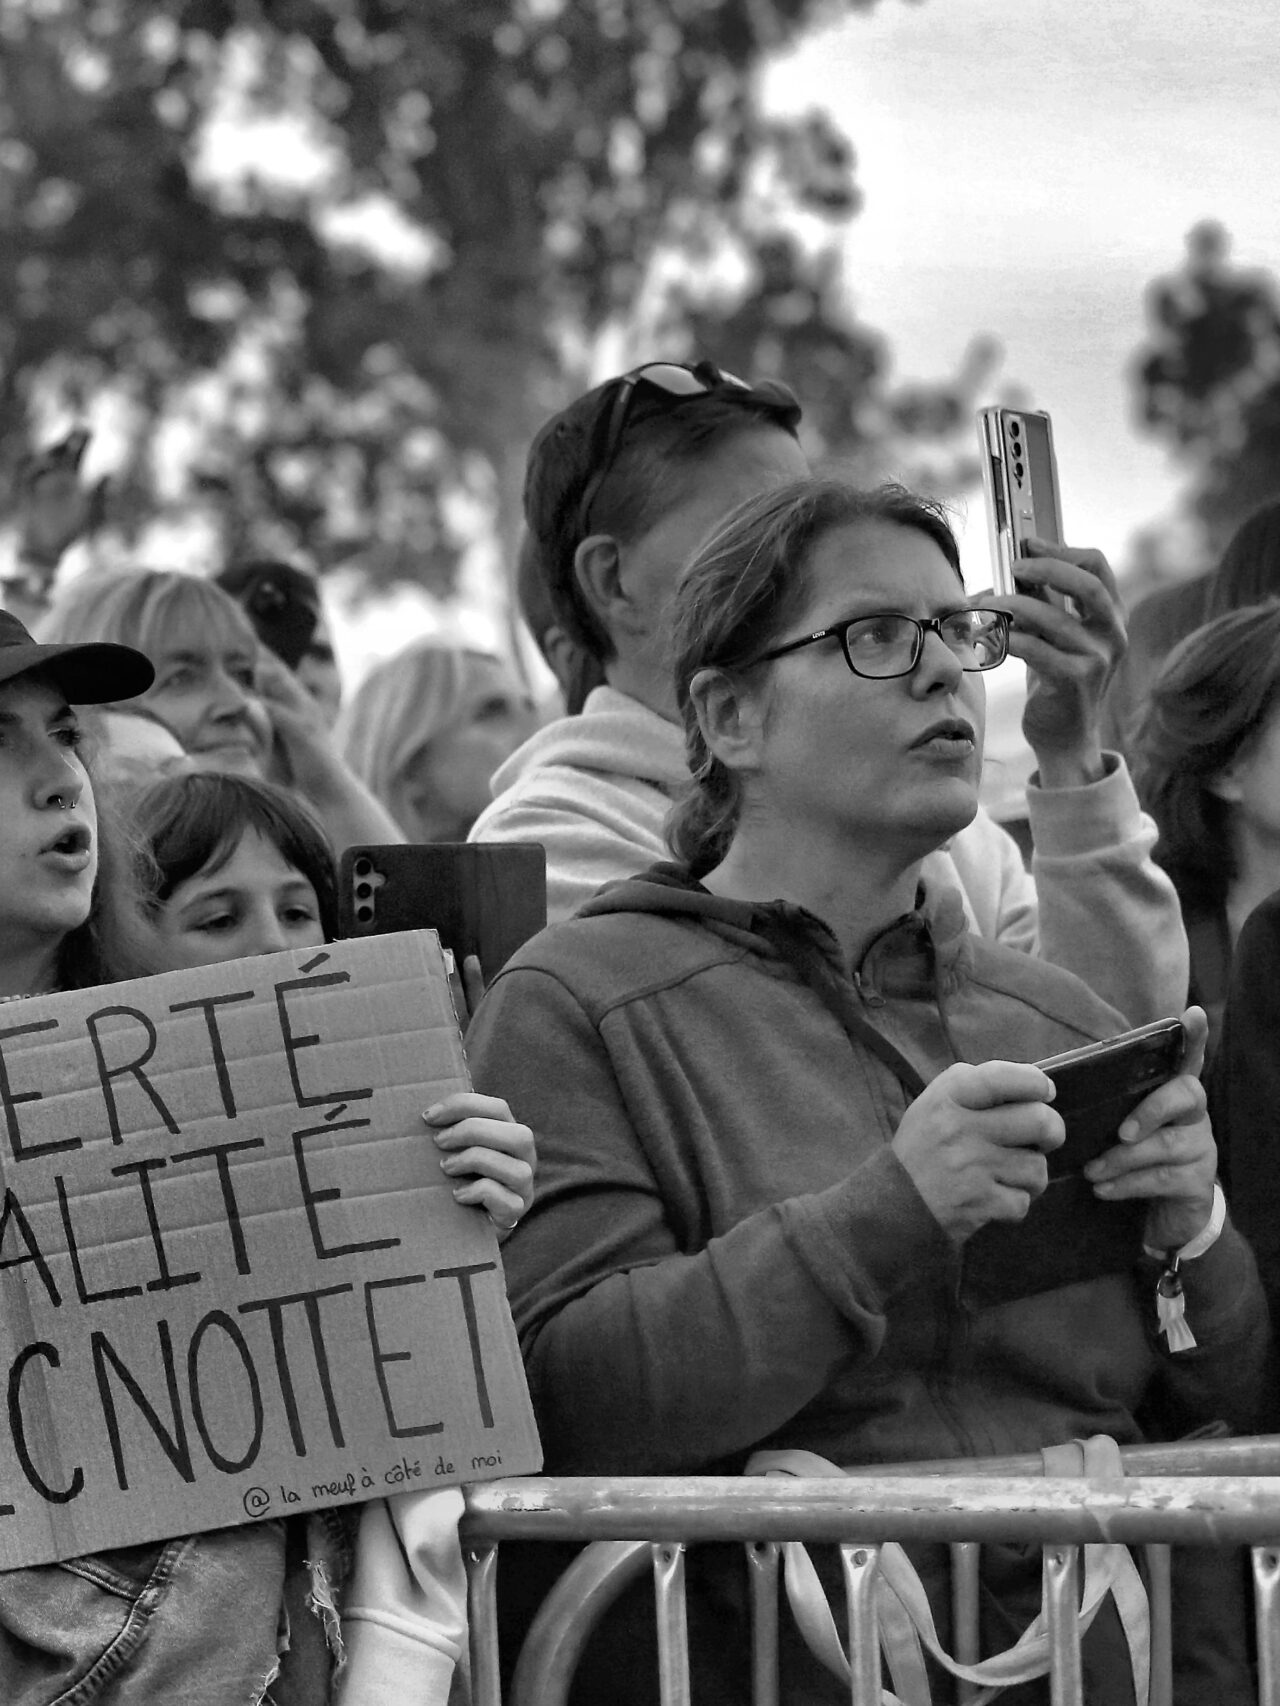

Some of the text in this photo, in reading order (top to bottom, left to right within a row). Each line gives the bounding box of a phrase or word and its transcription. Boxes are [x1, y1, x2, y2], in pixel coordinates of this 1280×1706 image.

[281, 1485, 302, 1504] la
[384, 1457, 422, 1485] côté
[435, 1456, 456, 1476] de
[472, 1450, 503, 1470] moi
